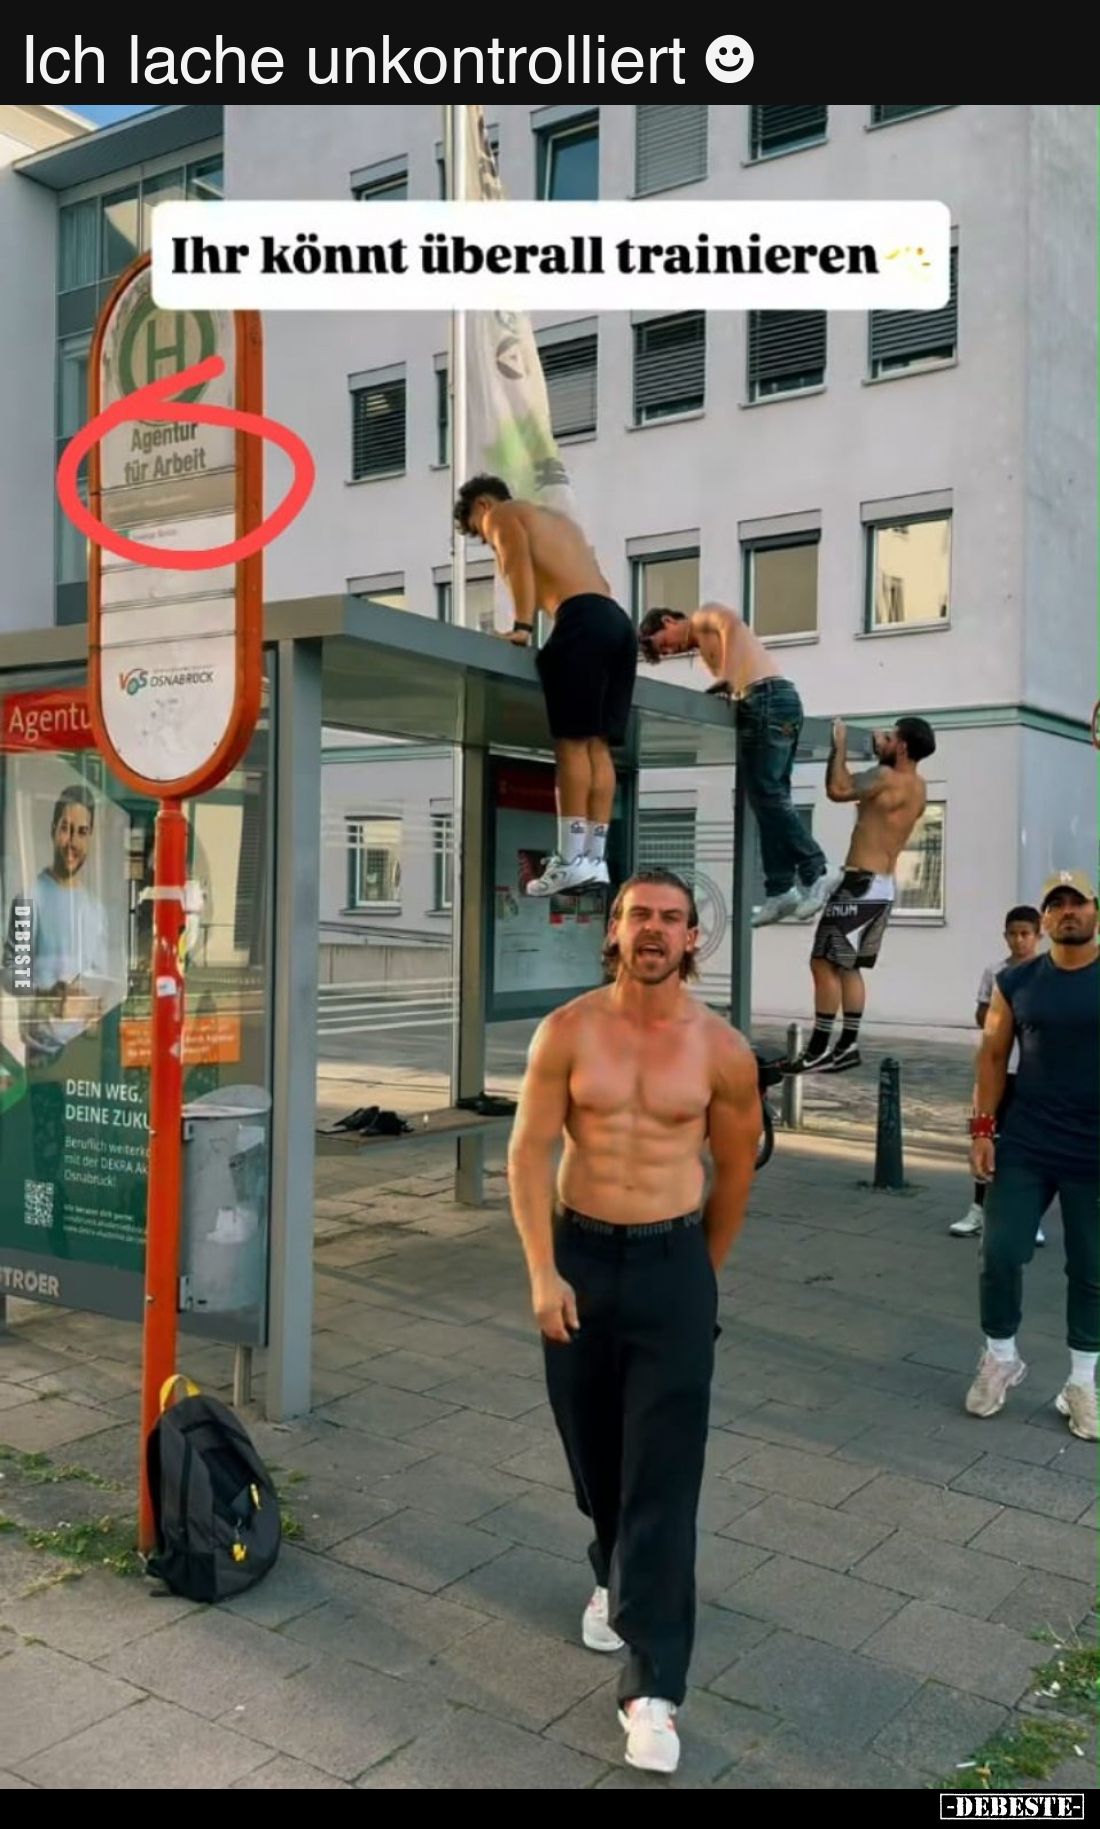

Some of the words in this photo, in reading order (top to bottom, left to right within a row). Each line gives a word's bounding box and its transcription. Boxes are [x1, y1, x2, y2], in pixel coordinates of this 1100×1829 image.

[131, 422, 197, 454] Agentur
[124, 459, 148, 484] für
[153, 447, 206, 478] Arbeit
[66, 1079, 101, 1099] DEIN
[105, 1083, 143, 1103] WEG.
[65, 1104, 109, 1125] DEINE
